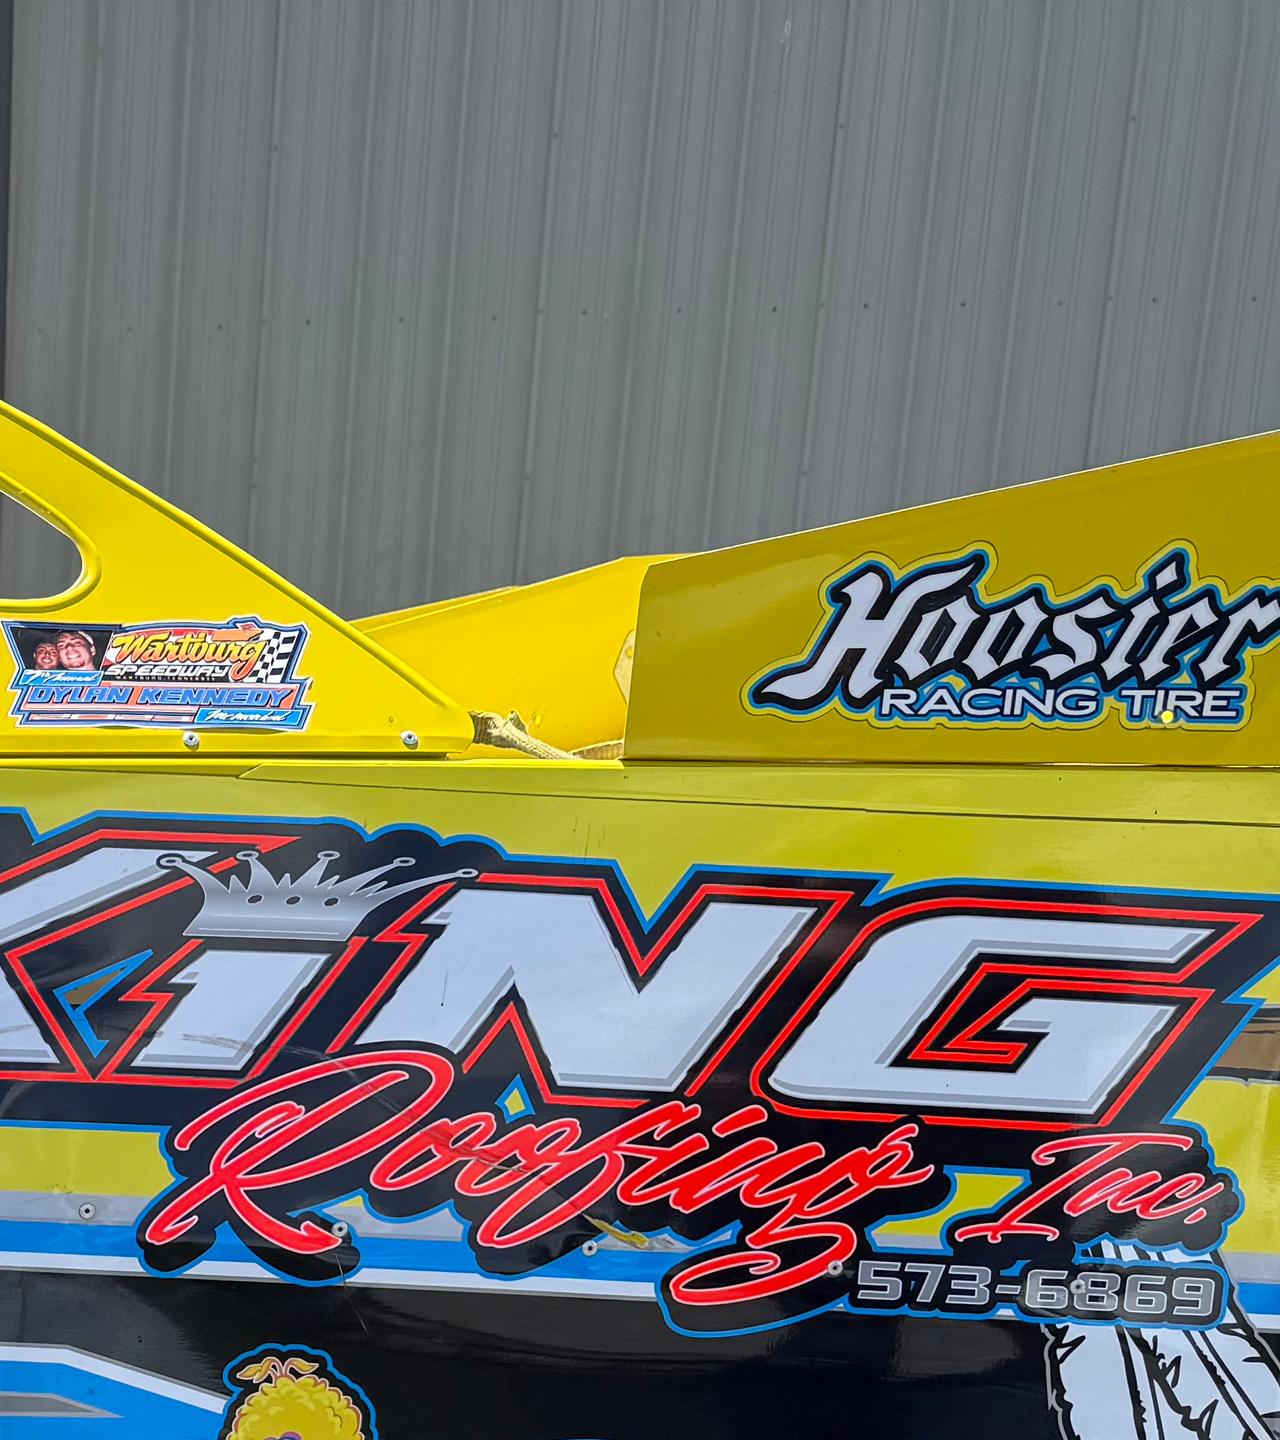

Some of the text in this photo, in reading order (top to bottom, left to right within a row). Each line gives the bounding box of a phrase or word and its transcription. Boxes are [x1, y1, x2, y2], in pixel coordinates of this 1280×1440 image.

[760, 556, 1280, 700] Hoosier
[104, 663, 231, 677] SPEEDWAY
[111, 630, 267, 681] Wartburg
[27, 686, 291, 707] DYLAN KENNEDY
[880, 687, 1243, 718] RACING TIRE
[954, 1132, 1225, 1244] Inc.
[856, 1259, 1220, 1318] 573-6869
